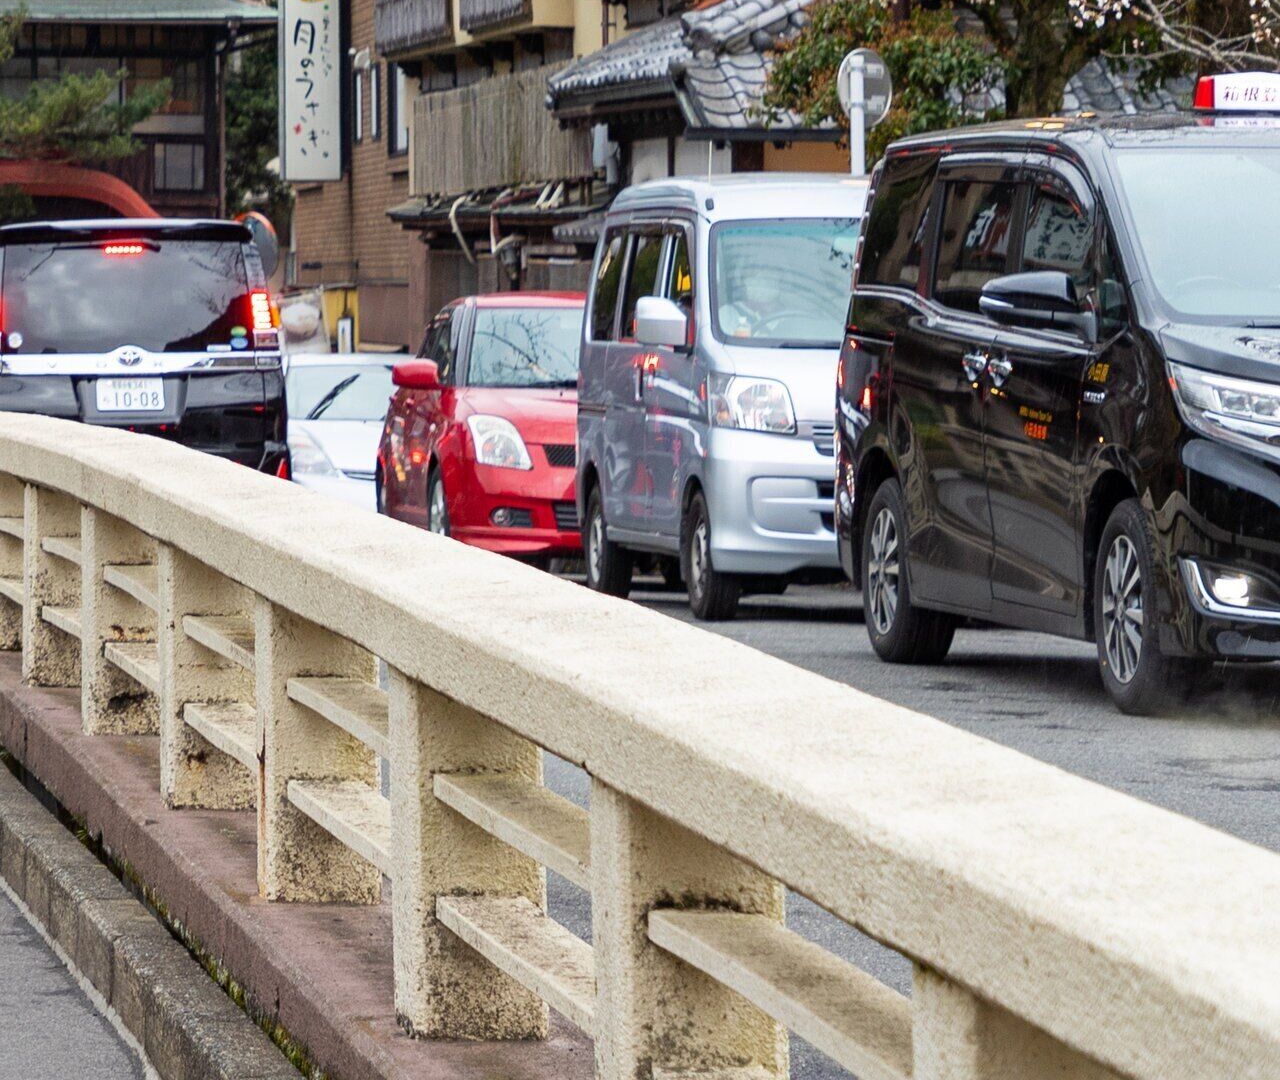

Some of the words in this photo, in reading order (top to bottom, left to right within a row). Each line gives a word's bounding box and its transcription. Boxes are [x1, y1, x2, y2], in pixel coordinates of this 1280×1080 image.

[293, 17, 329, 158] 月のうさぎ
[114, 391, 160, 408] 10-08
